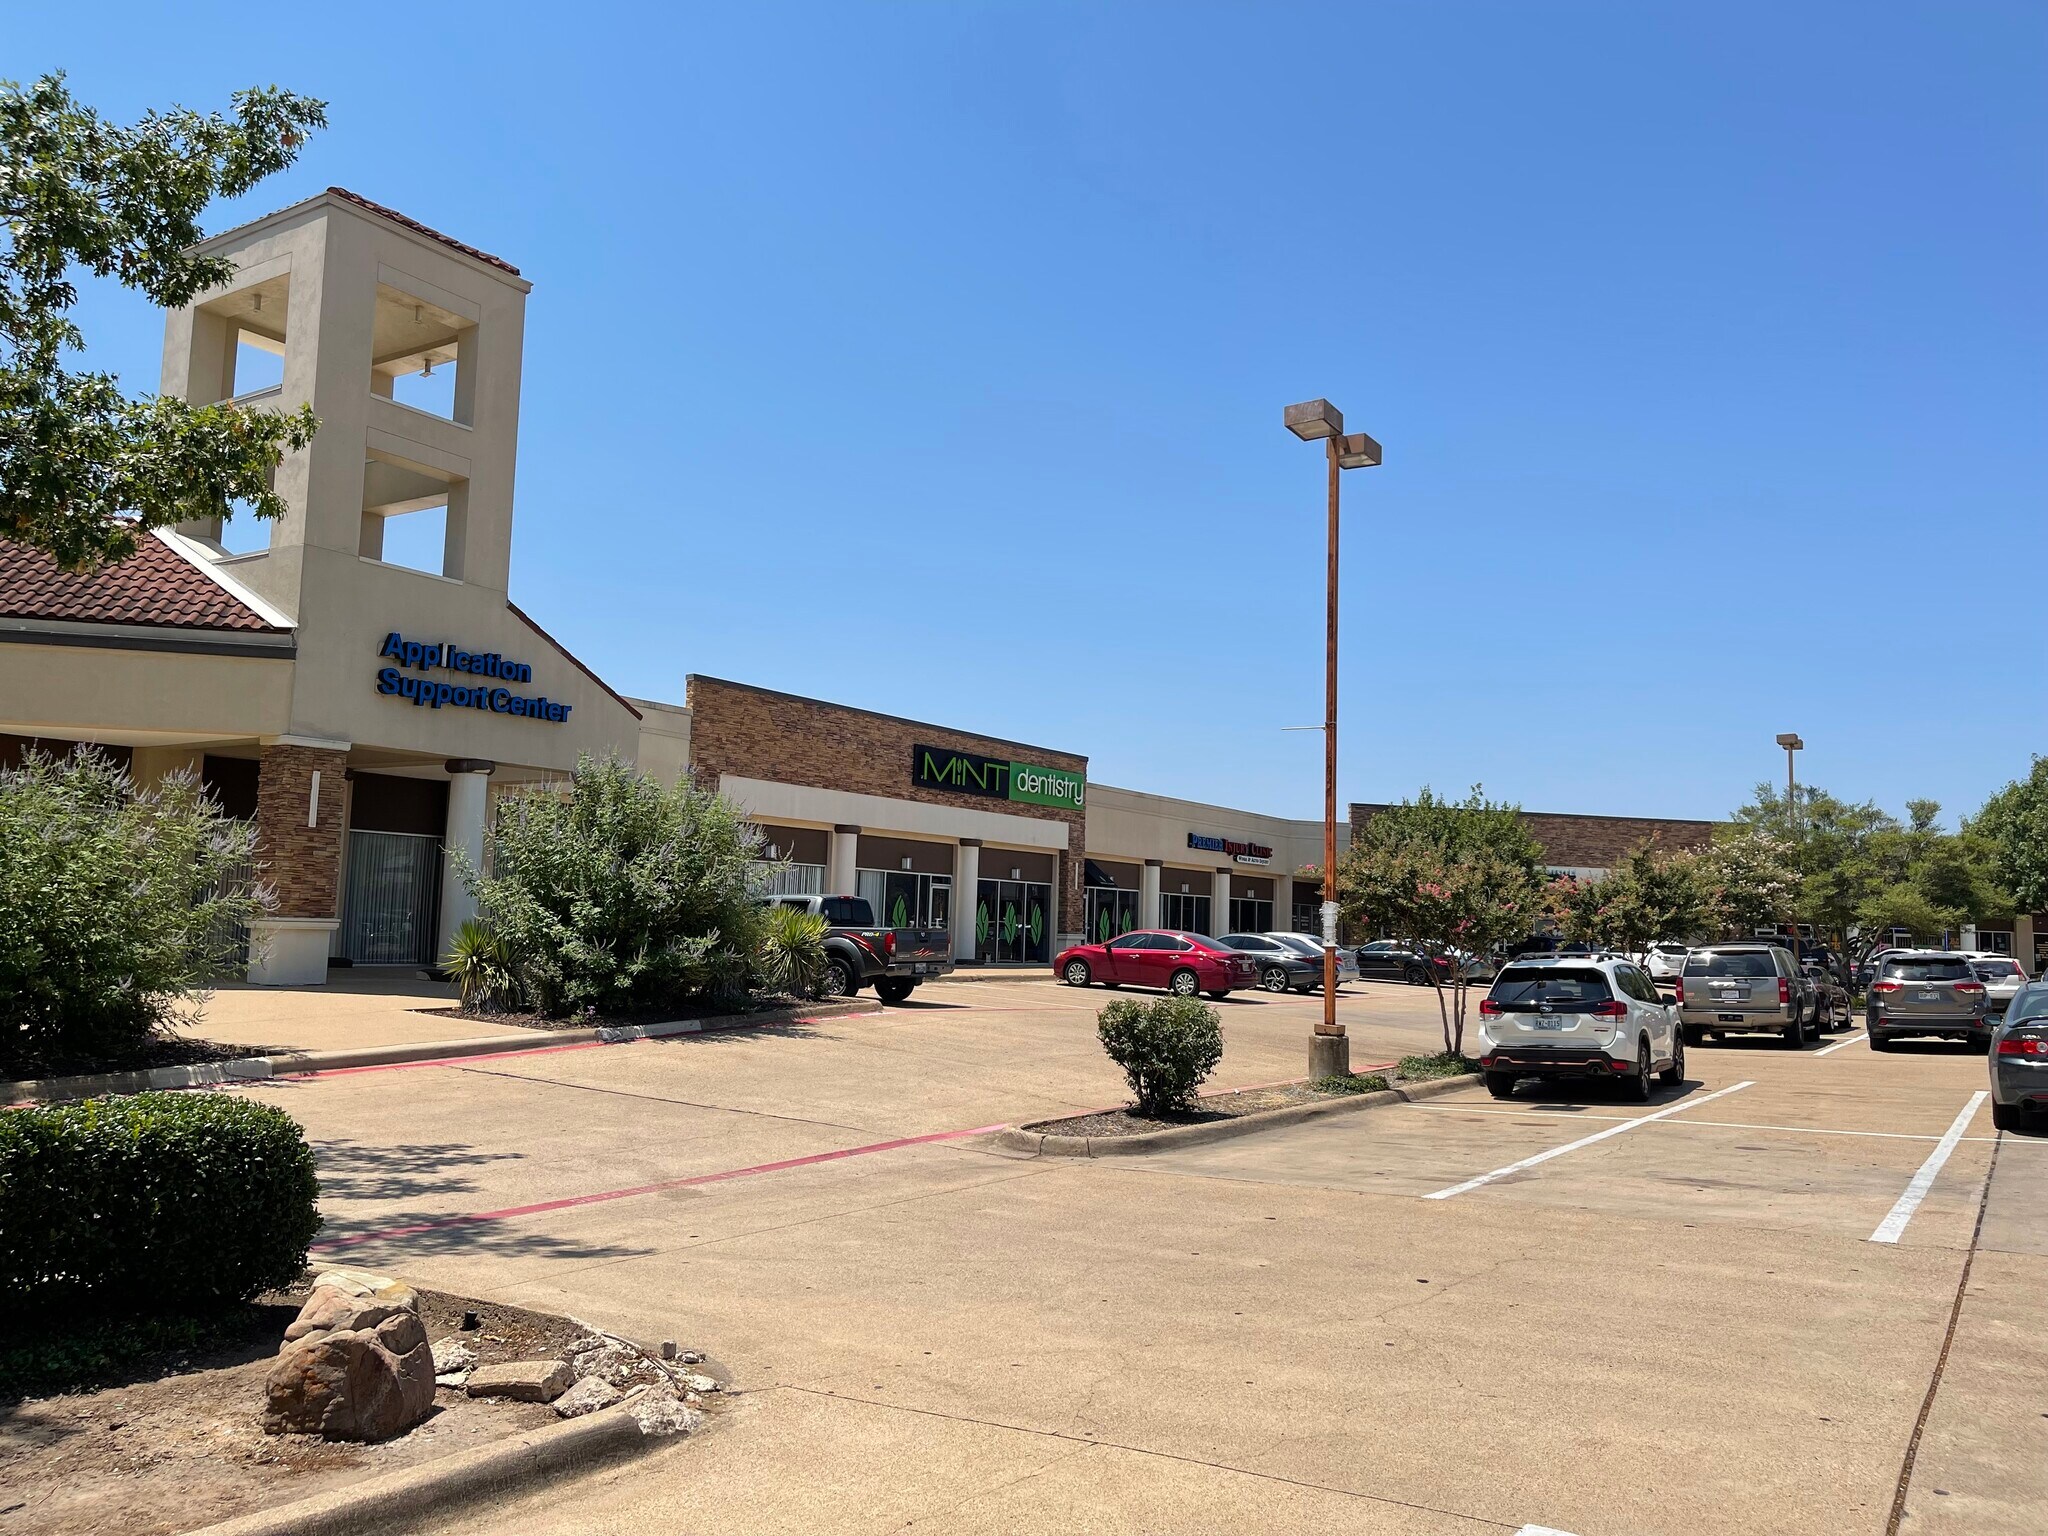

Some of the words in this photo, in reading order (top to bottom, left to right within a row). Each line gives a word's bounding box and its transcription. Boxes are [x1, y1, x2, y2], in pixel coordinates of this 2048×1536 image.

[381, 632, 532, 683] Application
[377, 668, 489, 710] Support
[489, 688, 573, 722] Center
[1017, 768, 1084, 806] dentistry
